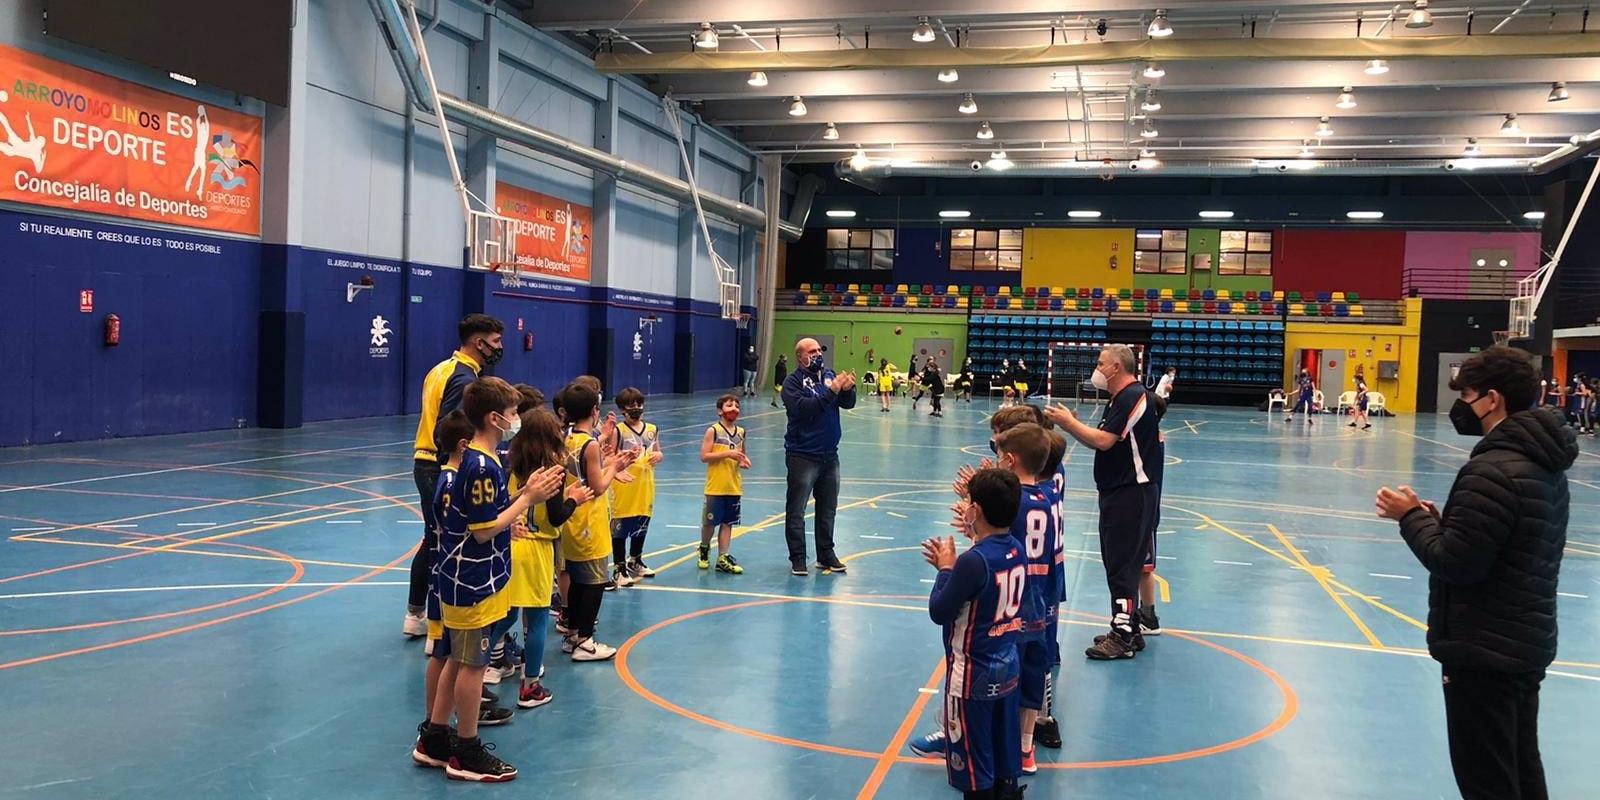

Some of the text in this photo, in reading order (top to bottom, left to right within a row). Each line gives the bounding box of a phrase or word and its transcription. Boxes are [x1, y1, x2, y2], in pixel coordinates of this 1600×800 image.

[13, 79, 193, 139] ARROYOMOLINOS ES
[53, 116, 167, 166] DEPORTE
[14, 169, 208, 219] Concejalía de Deportes
[206, 190, 251, 208] DEPORTES
[555, 209, 566, 226] ES
[20, 222, 221, 255] SI TU REALMENTE CREES QUE LO ES TODO ES POSIBLE
[535, 256, 544, 268] de
[544, 257, 571, 273] Deportes
[471, 478, 495, 505] 99
[1025, 509, 1048, 559] 8
[994, 564, 1026, 624] 10
